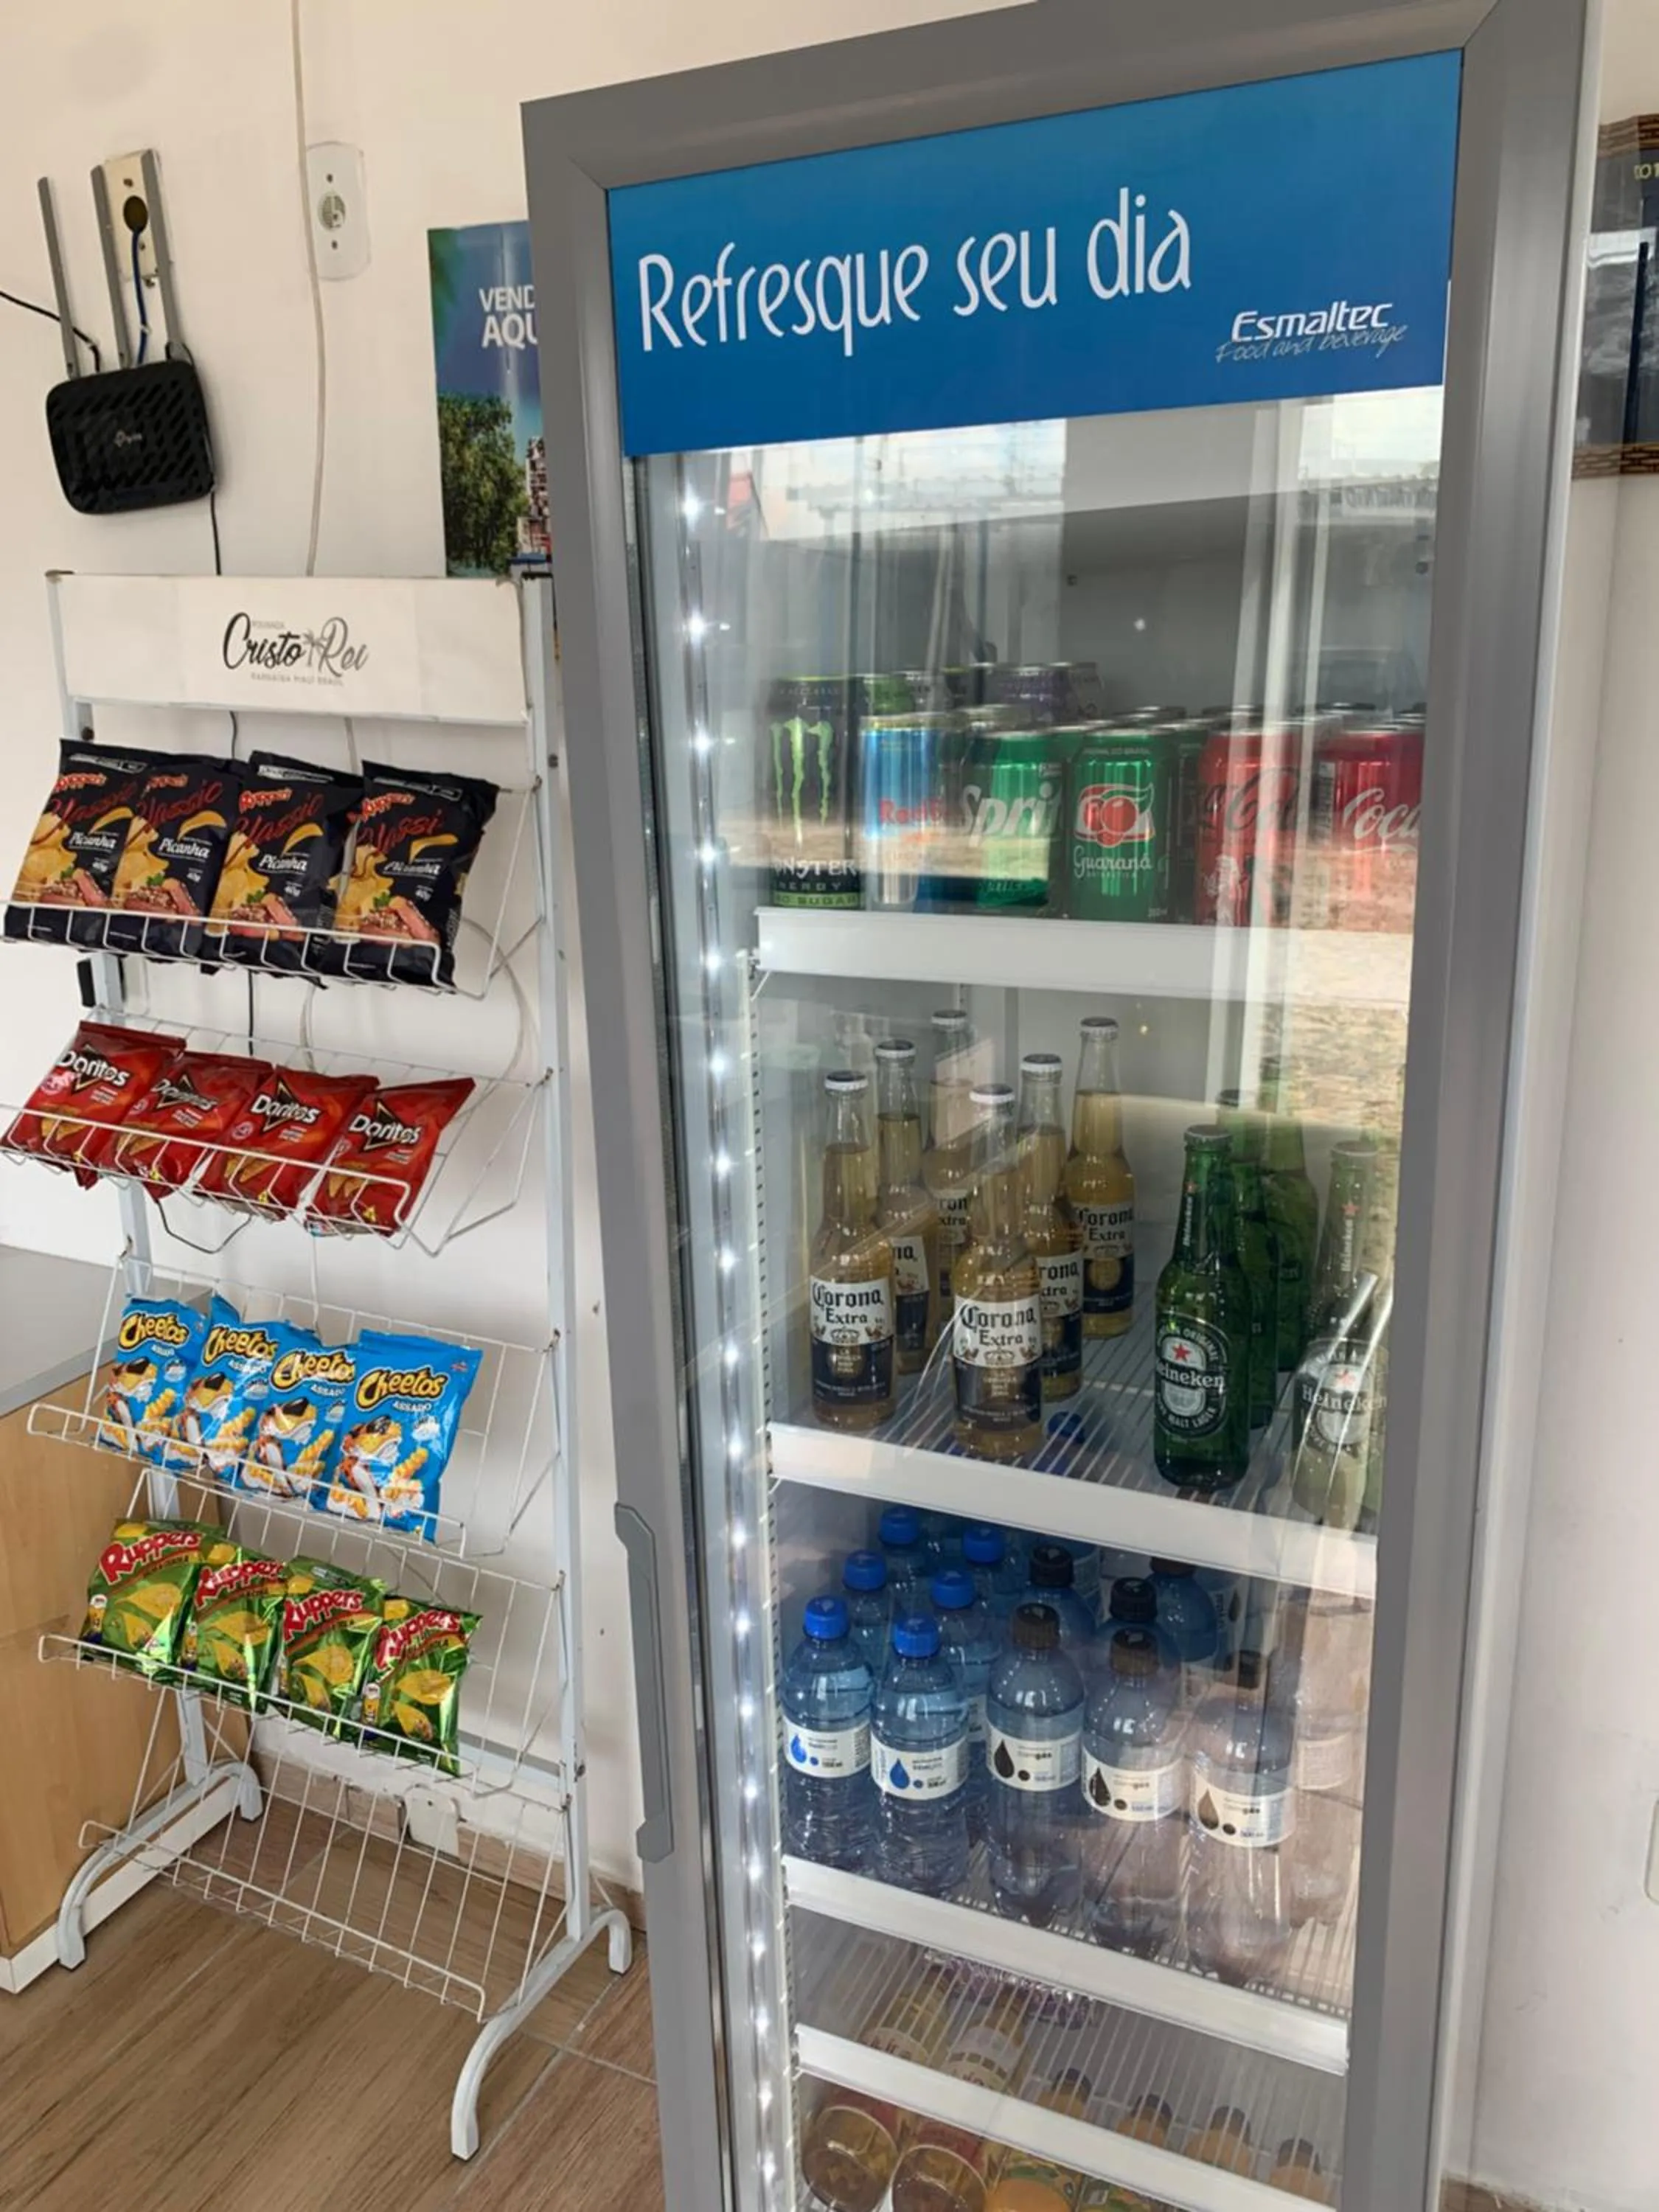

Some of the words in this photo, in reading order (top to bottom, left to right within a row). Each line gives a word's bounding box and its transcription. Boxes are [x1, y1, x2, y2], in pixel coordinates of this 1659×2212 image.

[637, 242, 930, 357] Refresque
[953, 226, 1059, 316] seu
[1086, 187, 1192, 301] dia
[1231, 300, 1394, 343] Esmaltec
[1215, 339, 1270, 363] Food
[1272, 335, 1313, 358] and
[1318, 324, 1409, 359] beverage
[223, 611, 305, 669] Cristo
[319, 616, 369, 678] Rei
[961, 783, 1062, 848] Sprit
[159, 837, 212, 860] Picanha
[57, 1050, 131, 1087] Doritos
[251, 1094, 321, 1124] Doritos
[349, 1114, 422, 1144] Doritos
[1088, 1228, 1126, 1242] Extra
[813, 1281, 884, 1310] Corona
[119, 1312, 189, 1351] Cheetos
[824, 1307, 869, 1326] Extra
[959, 1303, 1037, 1332] Corona
[202, 1326, 278, 1365] Cheetos
[978, 1329, 1024, 1347] Extra
[357, 1368, 448, 1410] Cheetos
[1157, 1362, 1225, 1391] eineken
[99, 1531, 204, 1585] Ruppers
[283, 1589, 365, 1643] Ruppers
